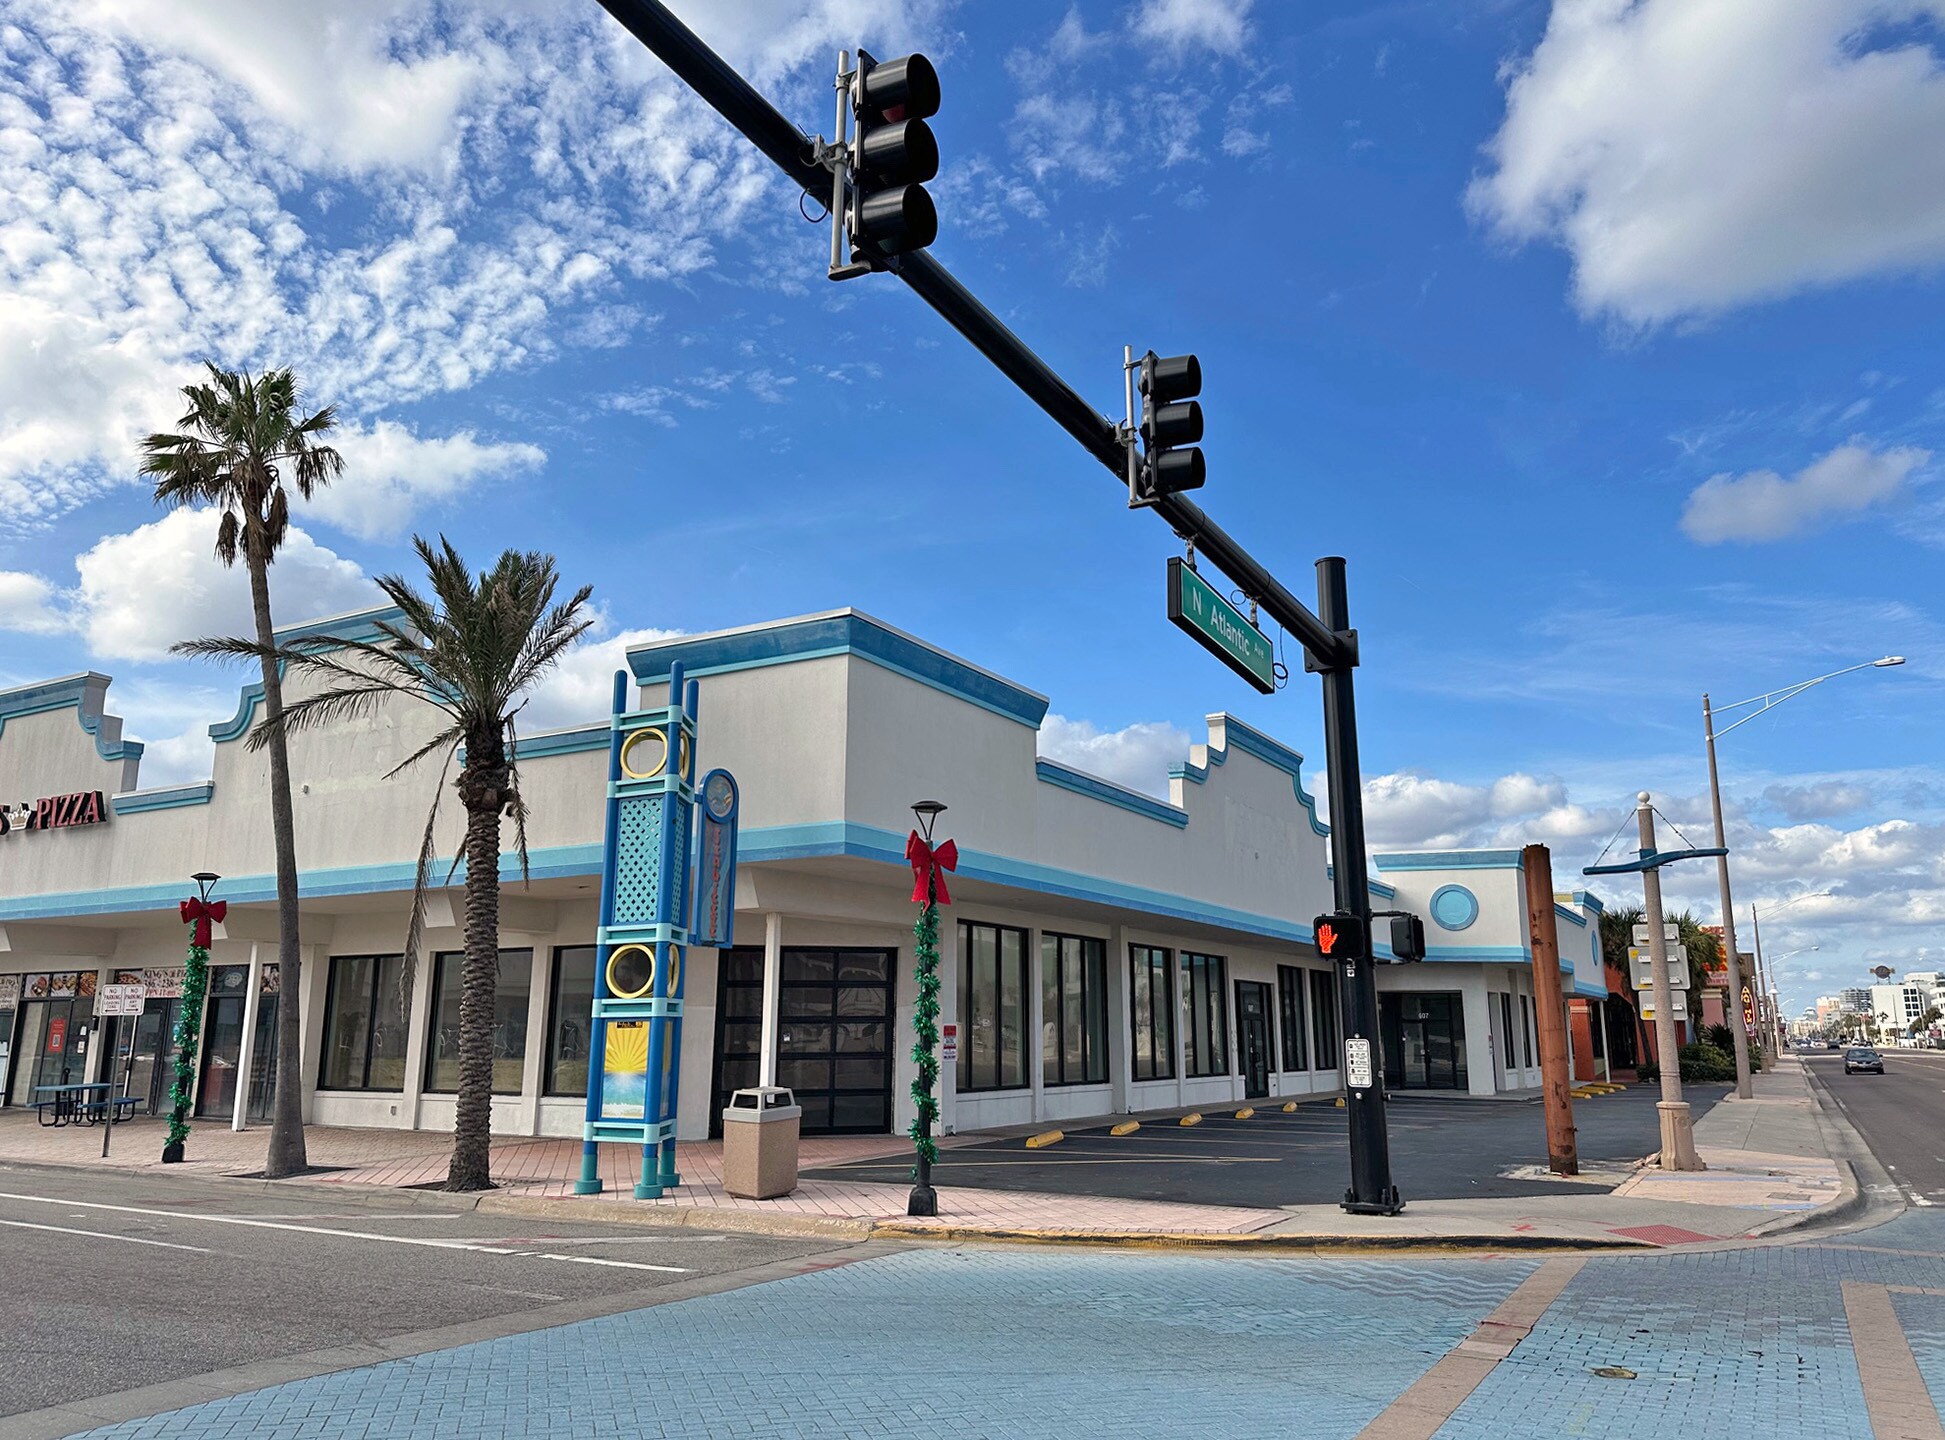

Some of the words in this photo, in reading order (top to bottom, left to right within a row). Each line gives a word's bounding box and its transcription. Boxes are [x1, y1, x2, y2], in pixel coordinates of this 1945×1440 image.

[1192, 587, 1202, 615] N
[1210, 605, 1250, 656] Atlantic
[1254, 642, 1265, 659] Ave
[36, 790, 101, 830] PIZZA
